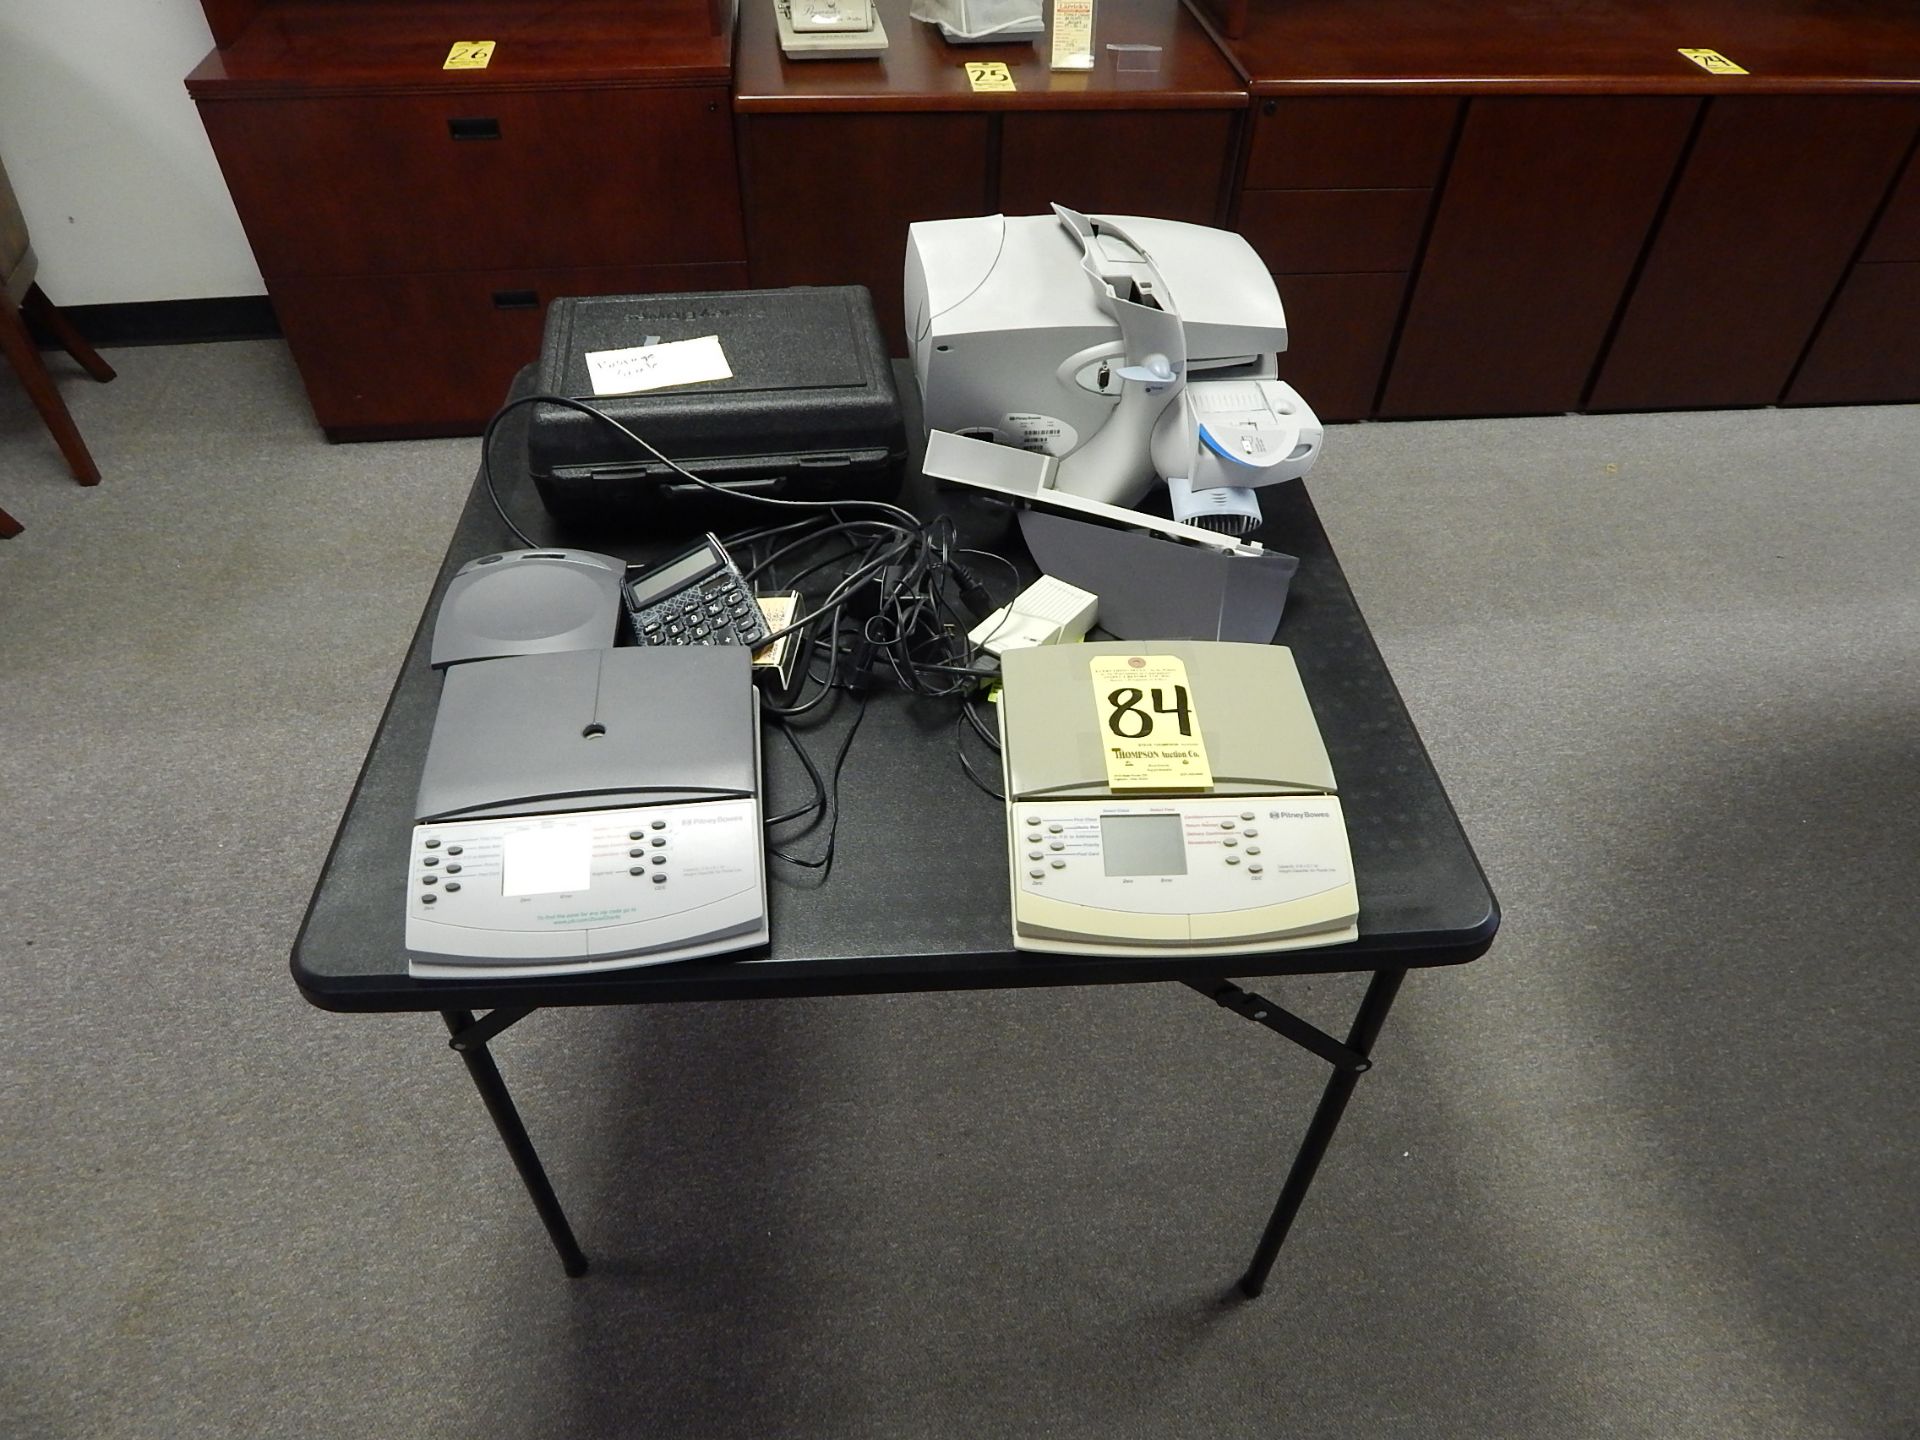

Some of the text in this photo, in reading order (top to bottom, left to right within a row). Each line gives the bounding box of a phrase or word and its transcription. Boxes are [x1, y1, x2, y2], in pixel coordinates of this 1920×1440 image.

[450, 48, 488, 60] 26
[971, 69, 1009, 82] 25
[690, 614, 698, 624] 9
[671, 624, 679, 634] 8
[696, 627, 704, 636] 6
[651, 635, 659, 644] 7
[1107, 684, 1193, 739] 84
[1111, 748, 1160, 759] THOMPSON
[1161, 751, 1188, 759] Auction
[717, 815, 743, 823] Bowes
[1281, 811, 1304, 820] Pitney
